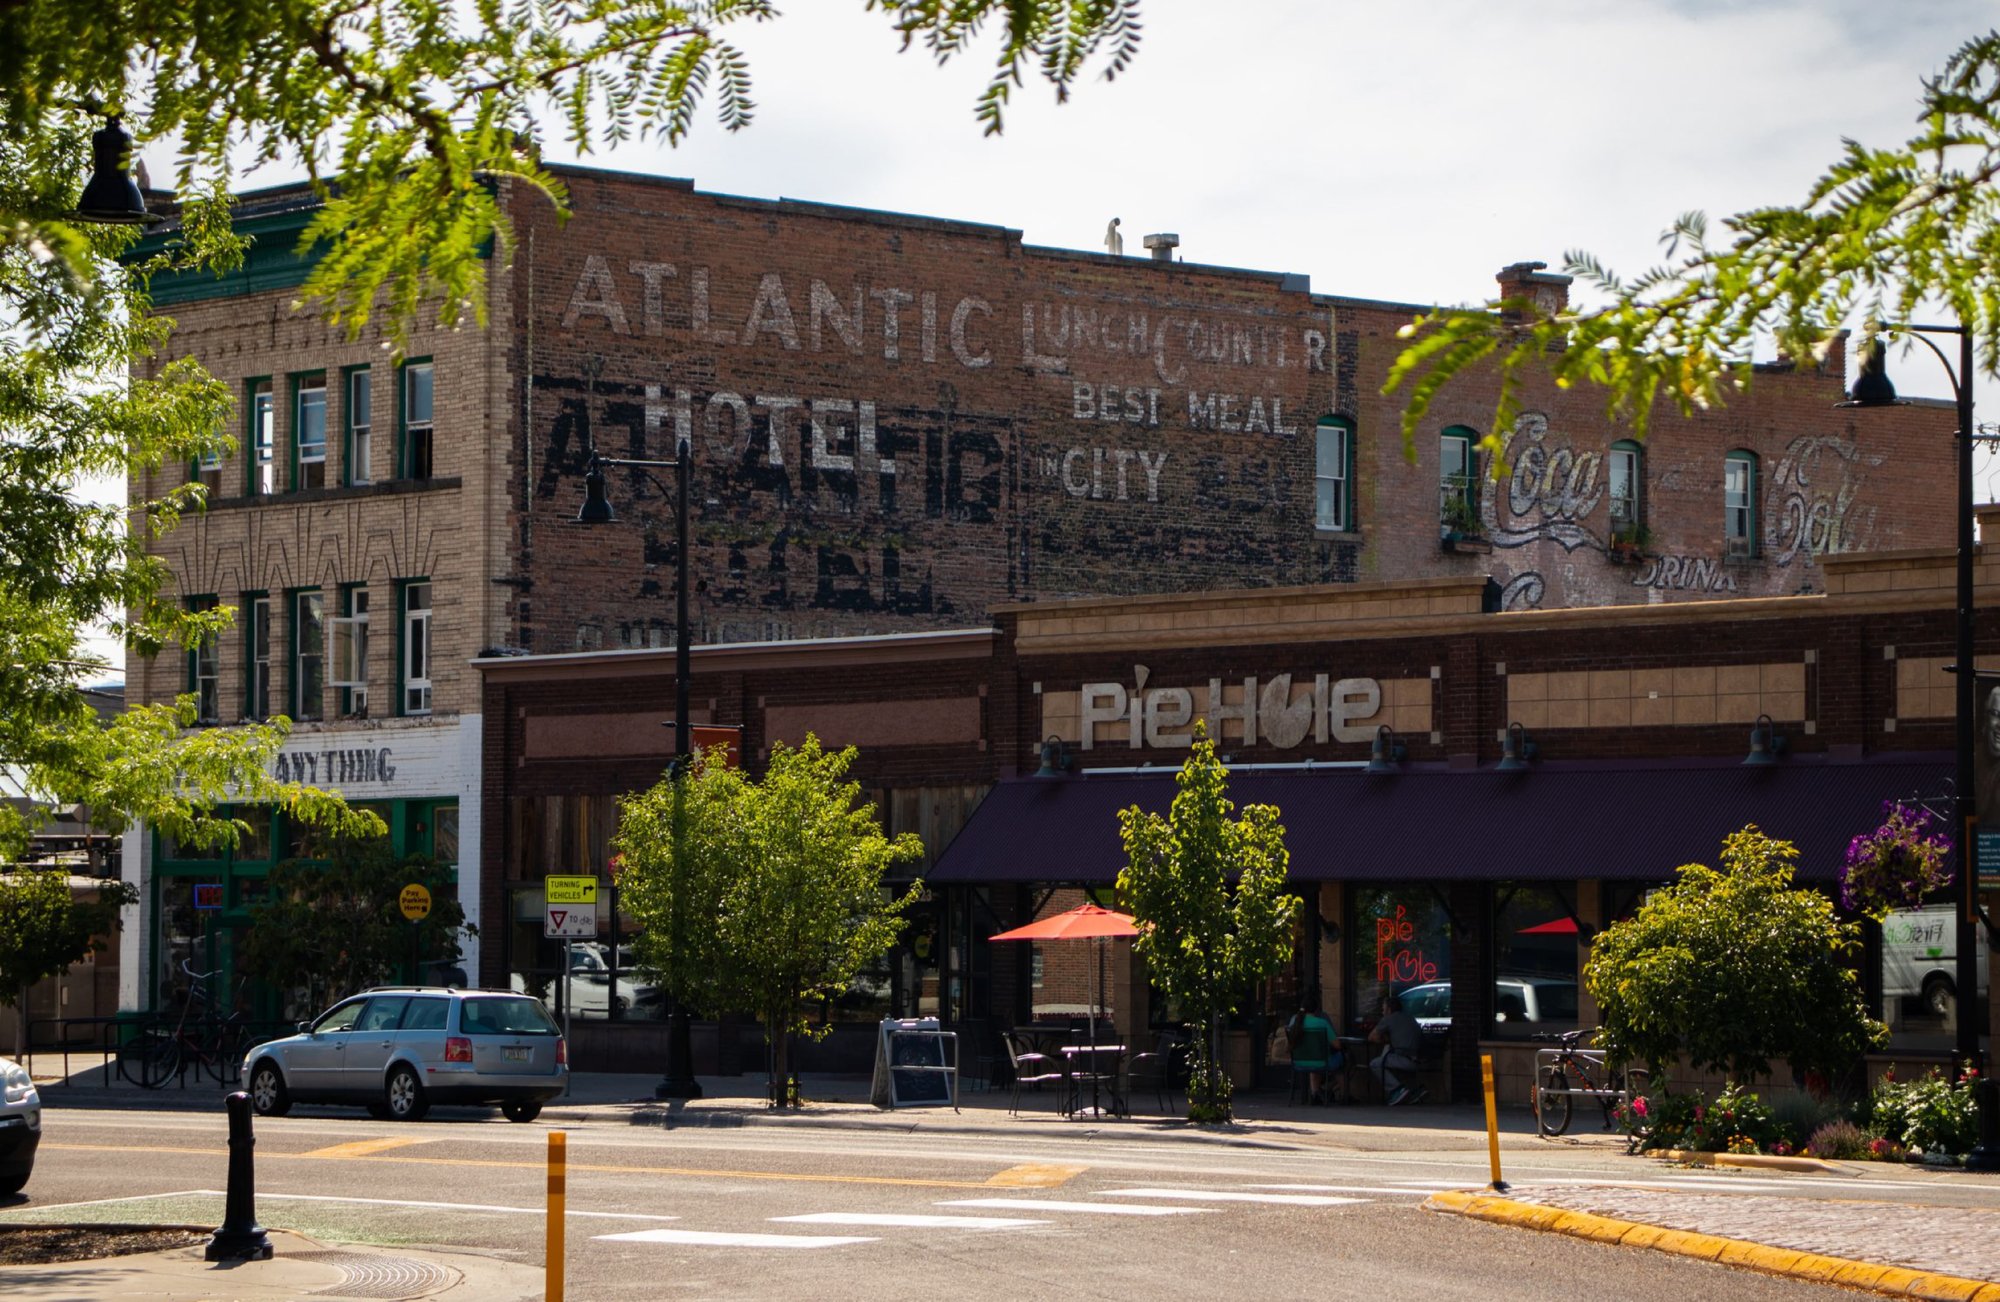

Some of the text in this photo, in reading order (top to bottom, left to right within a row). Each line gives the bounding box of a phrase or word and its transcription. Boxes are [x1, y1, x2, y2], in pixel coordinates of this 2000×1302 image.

[560, 253, 995, 370] ATLANTIC
[1022, 301, 1149, 373] LUNCH
[644, 383, 896, 475] HOTEL
[1071, 380, 1298, 437] BEST MEAL
[1060, 447, 1171, 503] CITY
[274, 747, 397, 785] ANYTHING
[549, 891, 581, 900] VEHICLES
[550, 880, 581, 889] TURNING
[569, 915, 579, 923] TO
